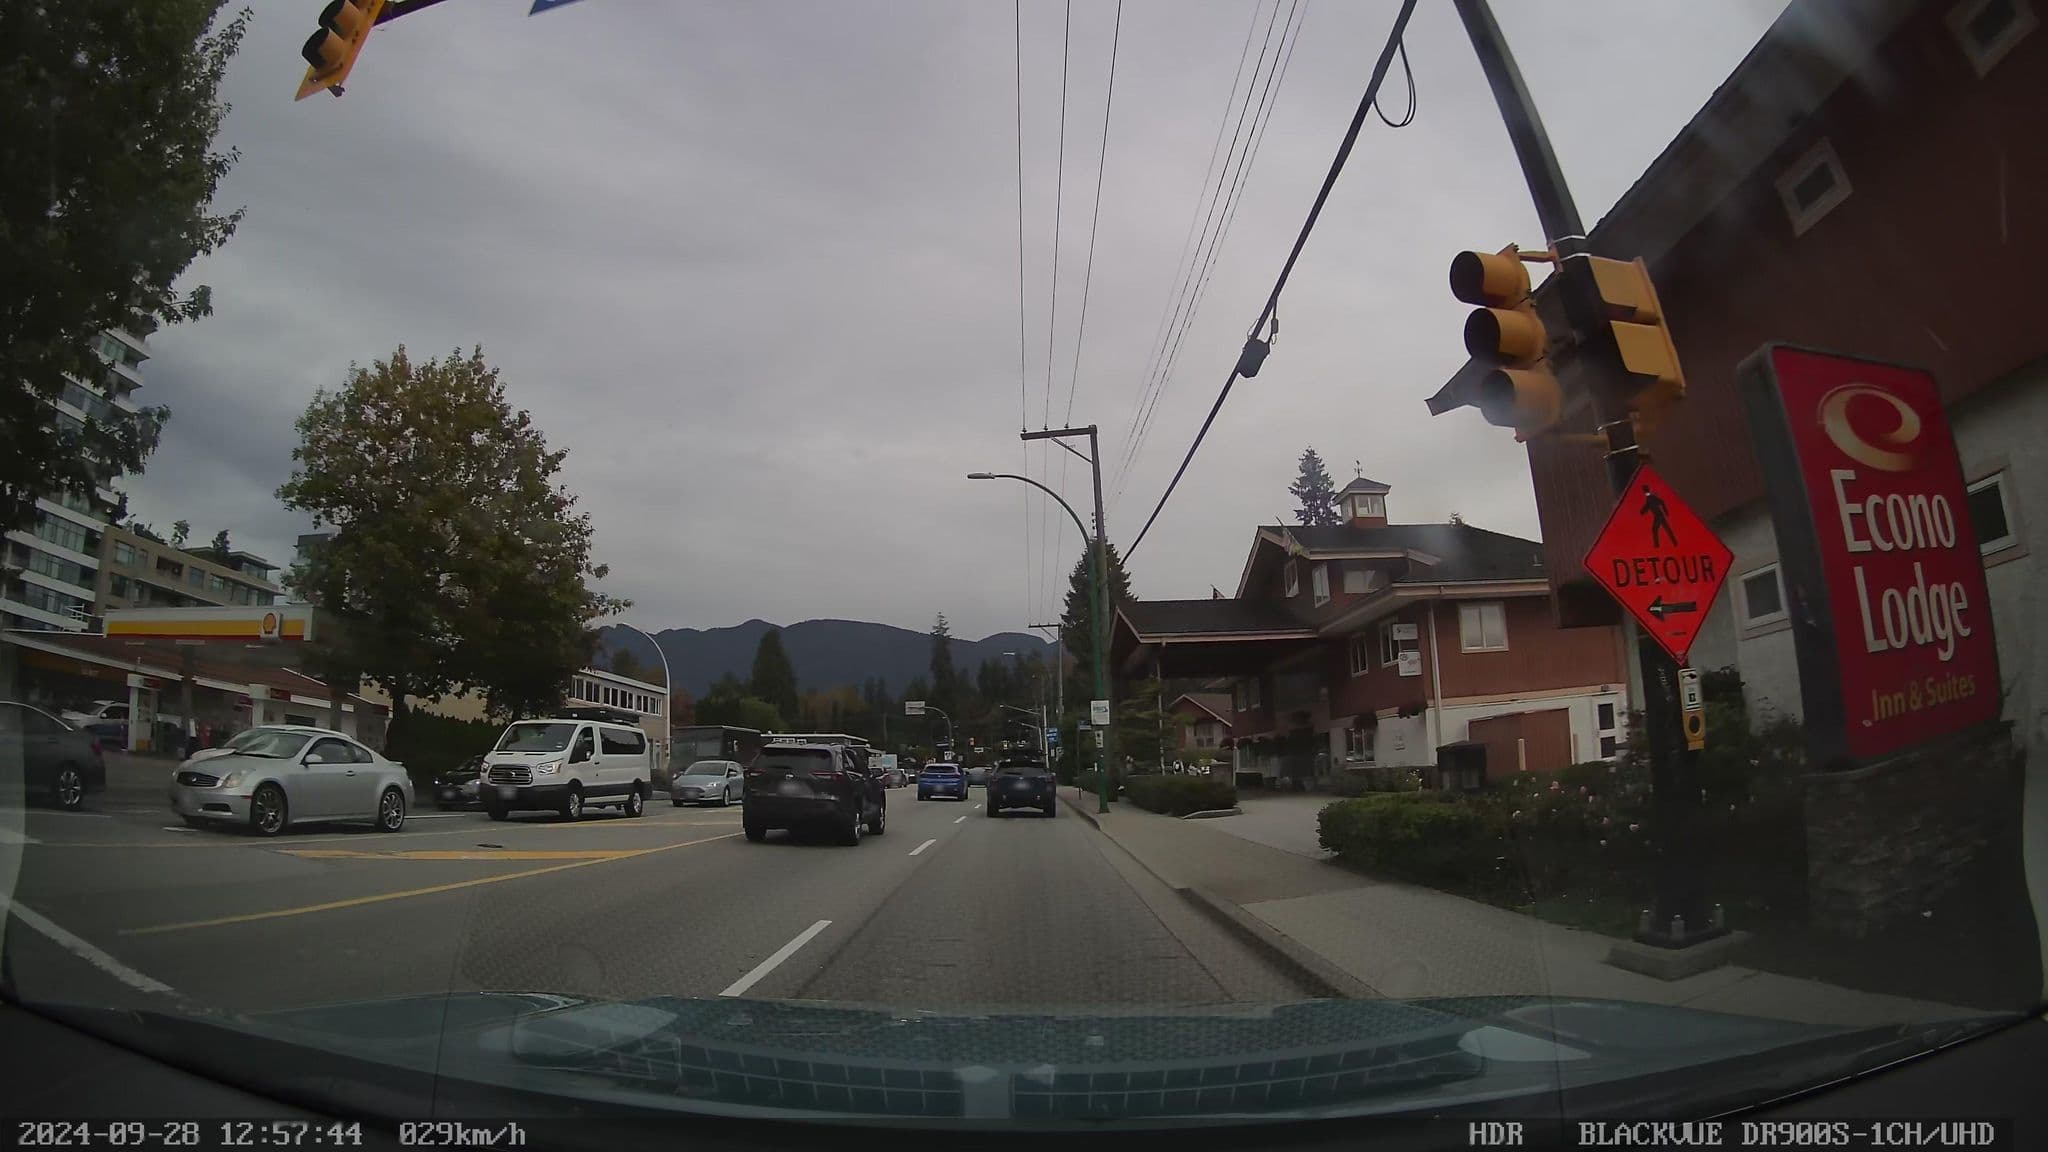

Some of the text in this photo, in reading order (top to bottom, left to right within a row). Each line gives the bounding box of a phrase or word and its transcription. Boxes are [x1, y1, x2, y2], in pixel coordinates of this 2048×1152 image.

[1831, 469, 1956, 552] Econo
[1613, 556, 1715, 587] DETOUR
[1854, 562, 1972, 662] Lodge
[1872, 673, 1976, 721] Inn & Suites
